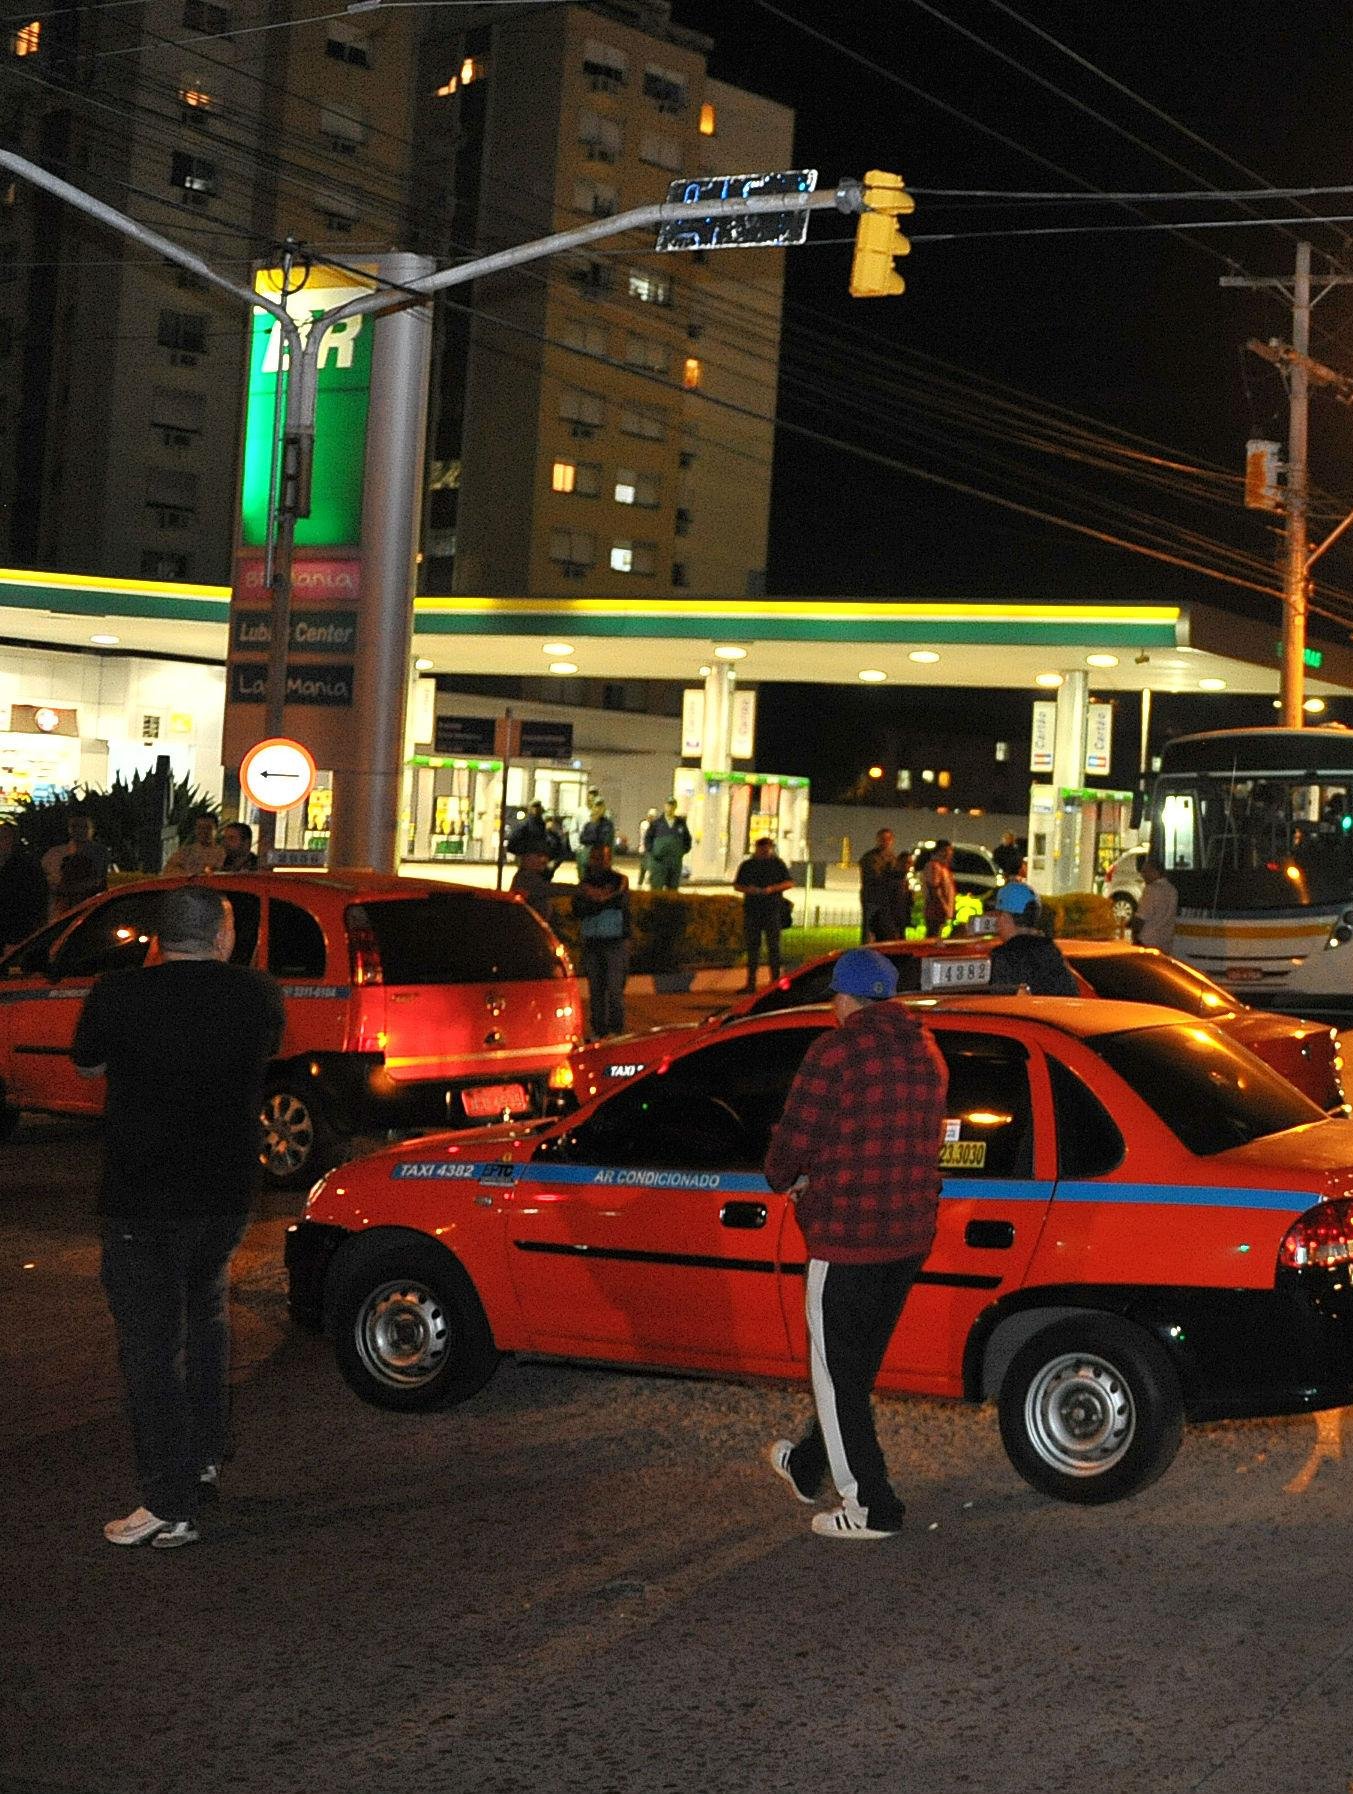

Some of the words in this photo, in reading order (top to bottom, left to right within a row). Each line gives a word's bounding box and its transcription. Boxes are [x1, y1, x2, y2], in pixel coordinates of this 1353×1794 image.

[295, 622, 353, 643] Center
[944, 963, 987, 982] 4382
[609, 1065, 635, 1077] TAXI
[939, 1143, 984, 1164] 23.3030
[400, 1164, 433, 1178] TAXI
[436, 1164, 475, 1178] 4382
[594, 1169, 615, 1183] AR
[617, 1170, 720, 1188] CONDICIONADO
